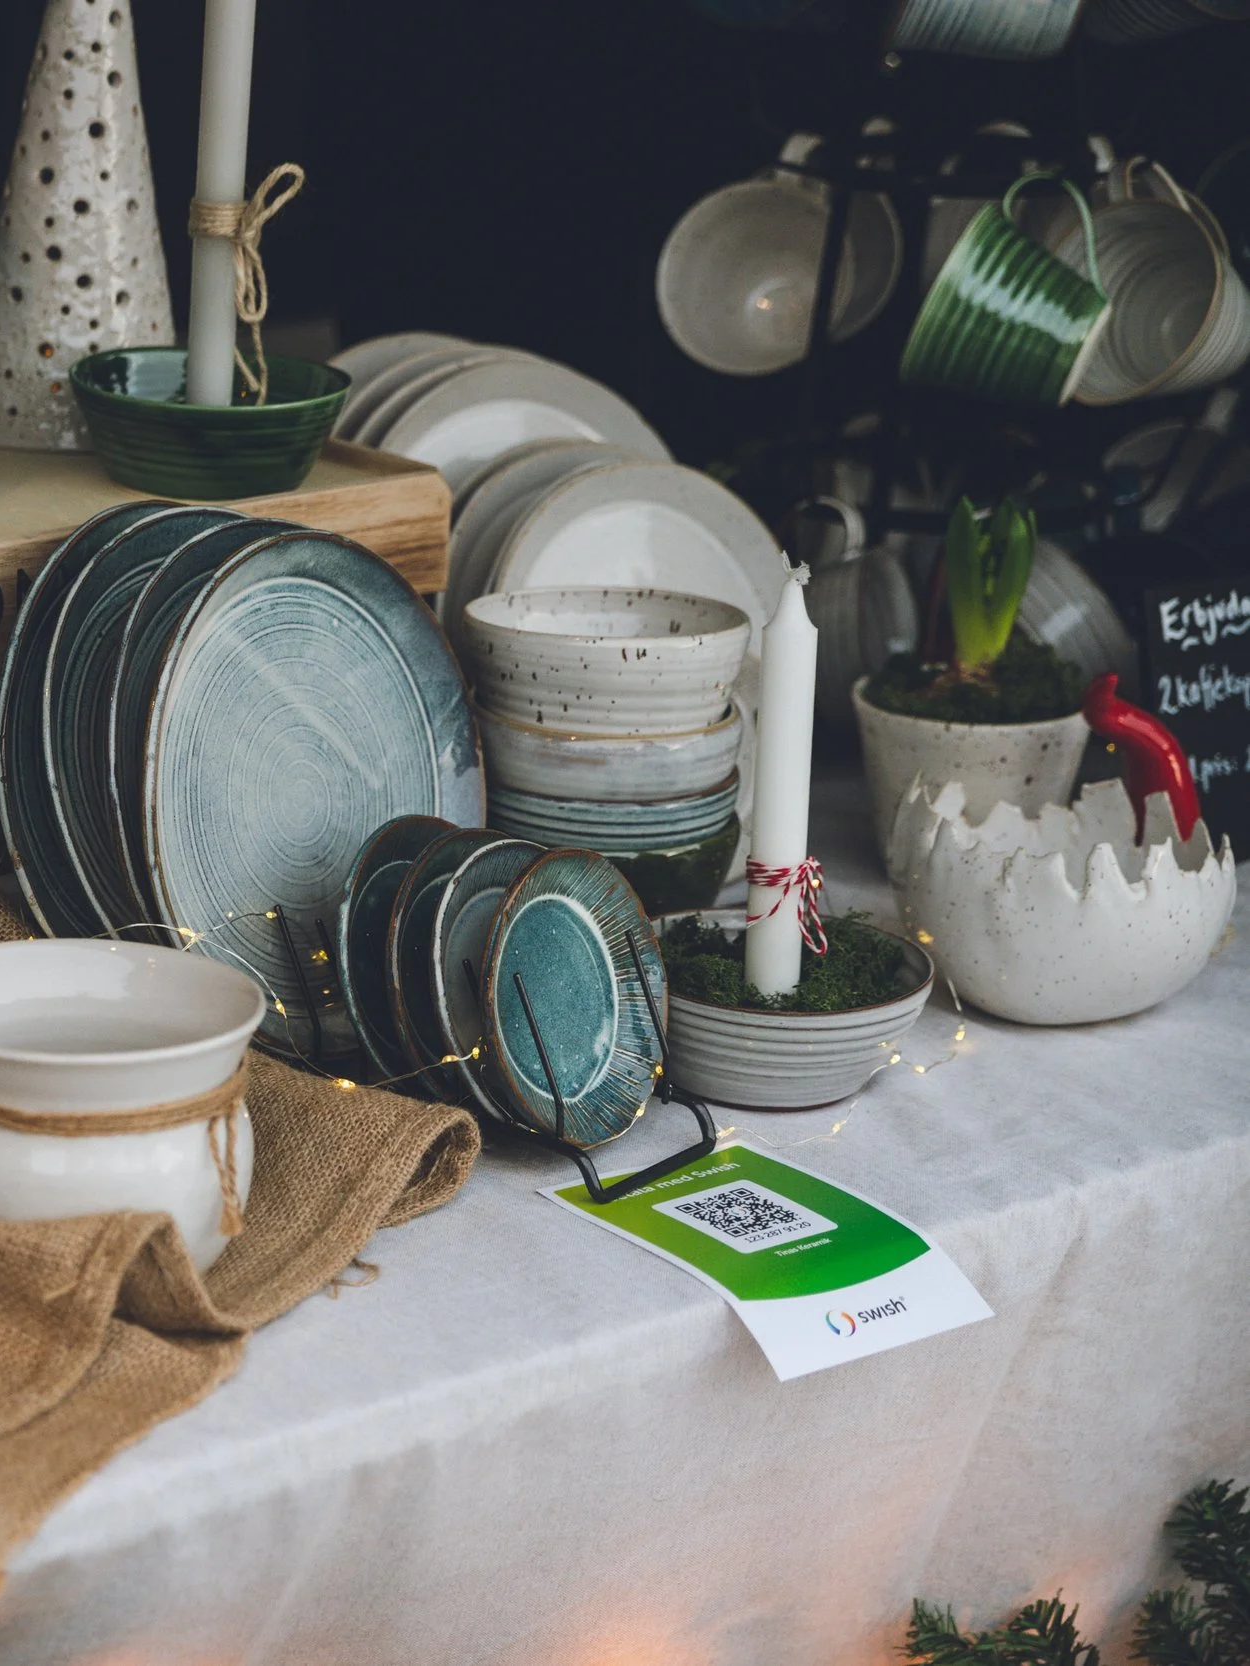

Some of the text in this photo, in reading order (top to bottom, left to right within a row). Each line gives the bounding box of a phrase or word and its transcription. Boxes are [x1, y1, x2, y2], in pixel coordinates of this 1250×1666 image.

[655, 1174, 693, 1189] med
[691, 1162, 741, 1178] Swish
[857, 1298, 907, 1324] swish
